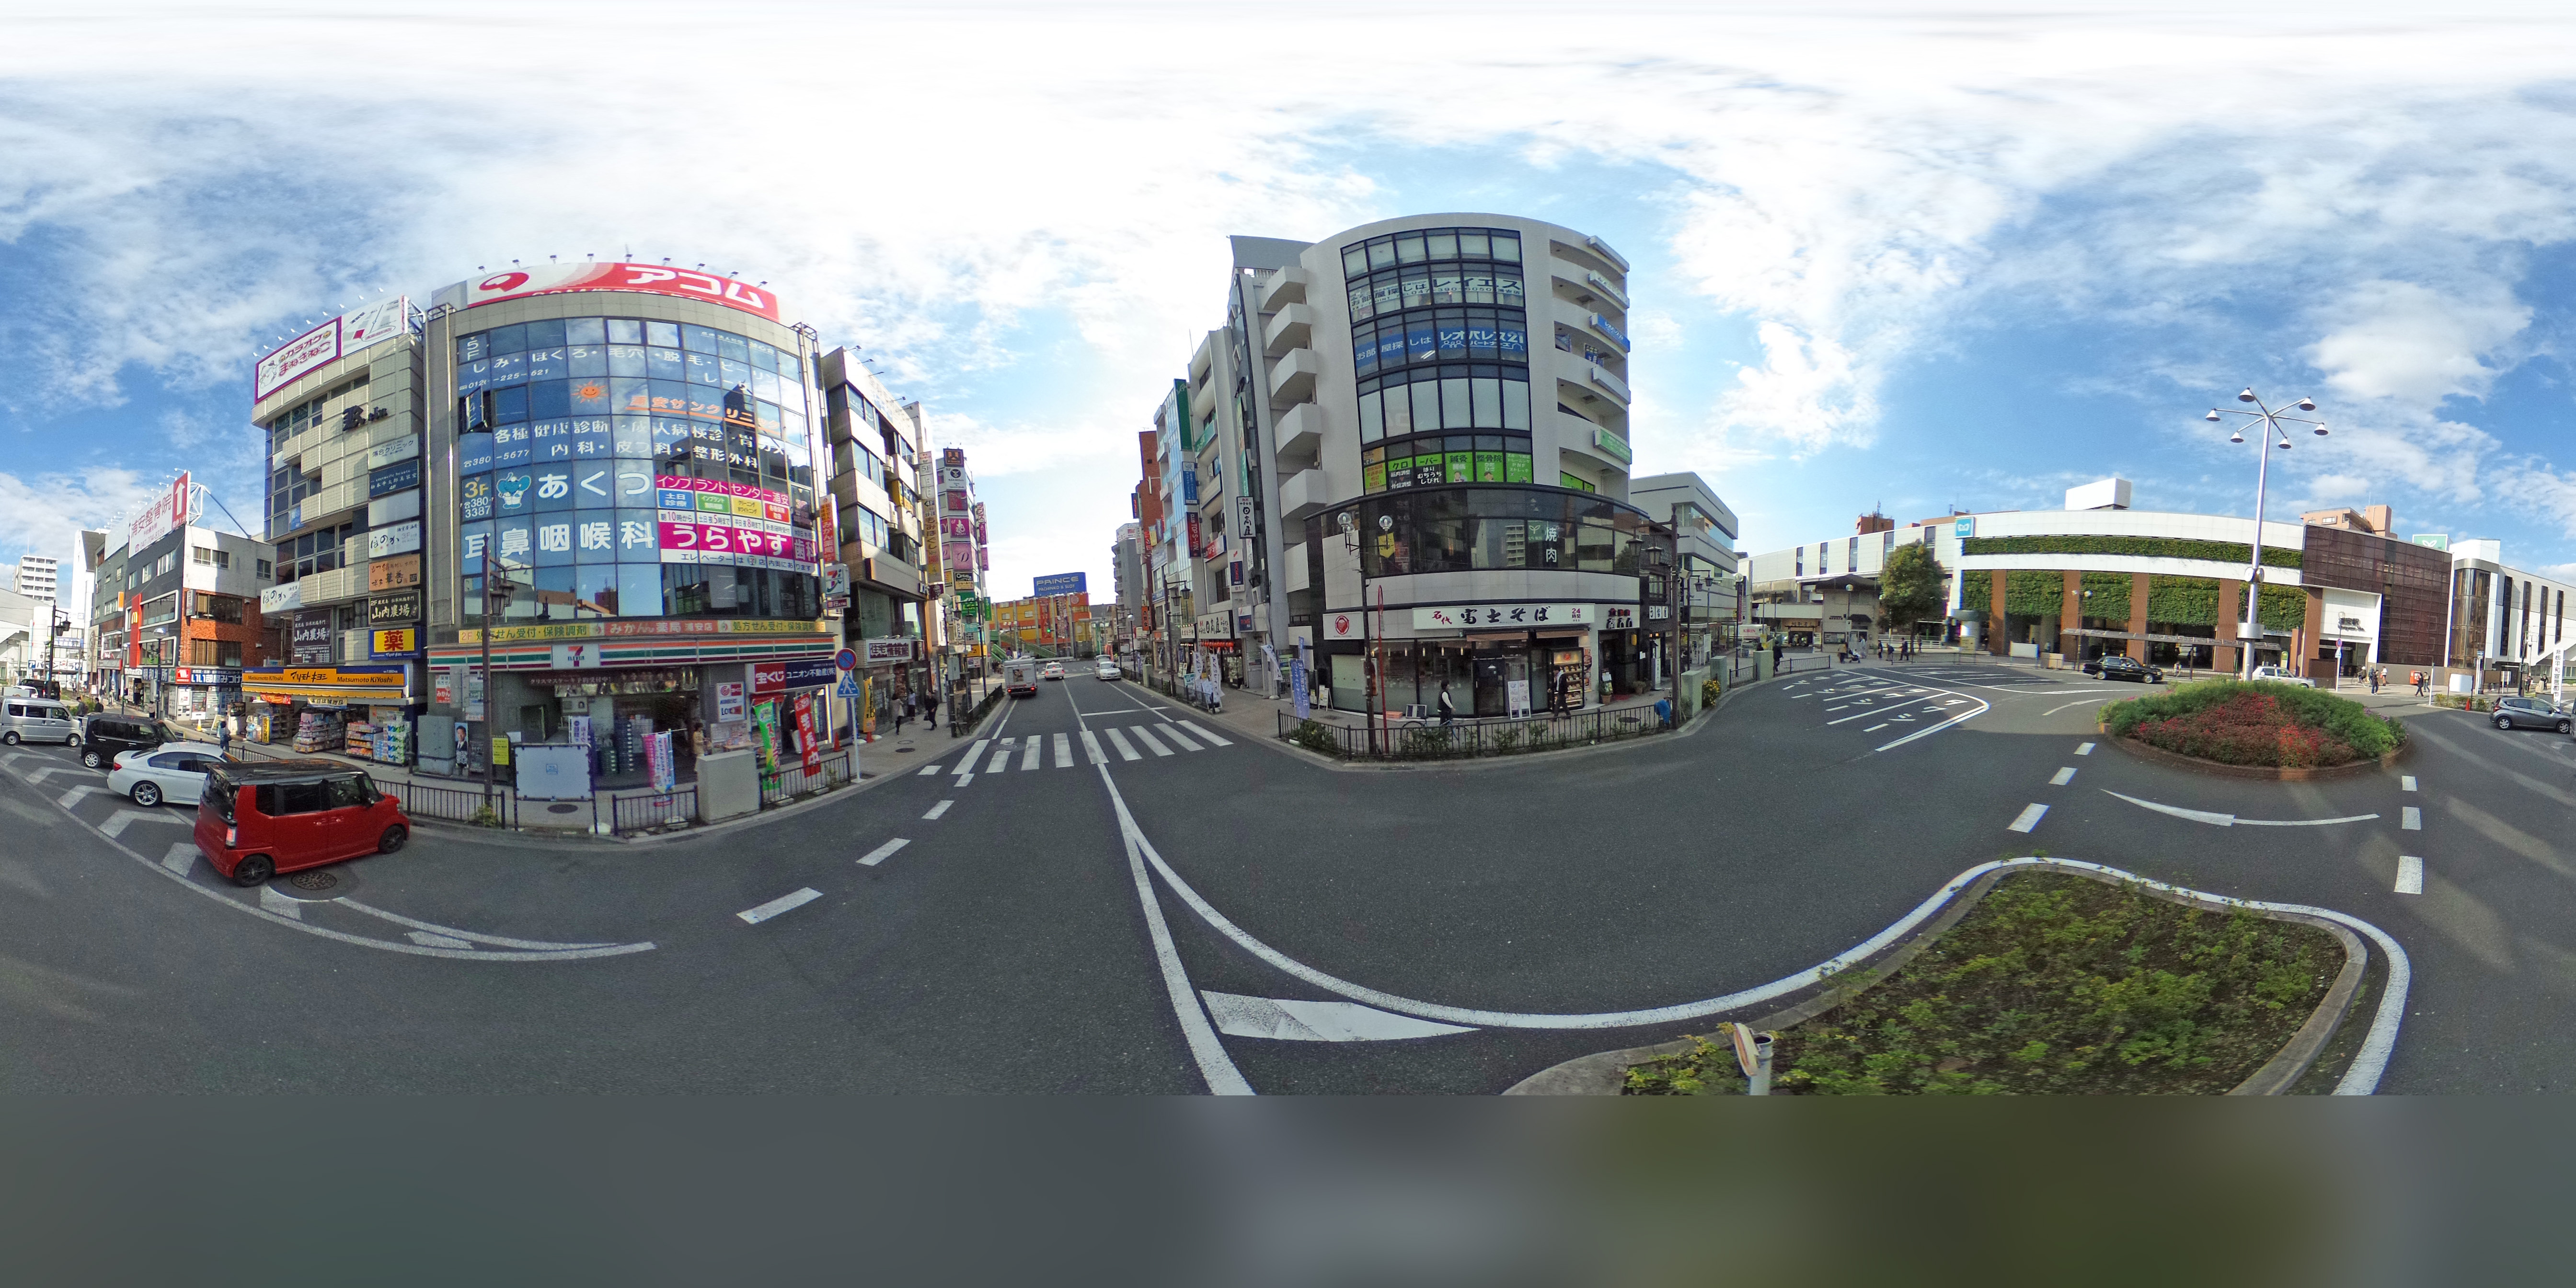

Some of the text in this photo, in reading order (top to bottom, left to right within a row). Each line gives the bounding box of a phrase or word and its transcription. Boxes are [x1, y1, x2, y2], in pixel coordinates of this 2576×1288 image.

[626, 267, 764, 308] アコム
[1433, 278, 1521, 290] レイエス
[1357, 330, 1524, 360] お部屋探しは レオパレス21
[279, 340, 332, 378] まねきねこ
[1392, 456, 1438, 469] クローバー
[1476, 454, 1503, 462] 整骨院
[464, 481, 489, 498] 3F
[539, 471, 651, 498] あくつ
[657, 475, 789, 506] インプラントセンター浦安
[465, 506, 491, 518] 3387
[1242, 506, 1253, 536] 日高屋
[464, 520, 655, 560] 耳鼻咽喉科
[673, 524, 817, 562] うらやす歯科
[1545, 527, 1558, 563] 焼肉
[681, 552, 744, 564] エレベーターは
[1036, 576, 1079, 586] PRINCE
[371, 603, 410, 620] 山内農場
[1460, 606, 1552, 624] 富士そば
[610, 621, 713, 634] みかん薬局 浦安店
[1205, 616, 1222, 634] 日高屋
[294, 627, 326, 643] 山内農場
[384, 630, 404, 651] 薬
[461, 632, 473, 642] 2F
[870, 644, 909, 658] 住宅情報館
[290, 671, 328, 682] マツモトキヨシ
[755, 667, 836, 684] 宝くじ ユニオン不動産(株)
[2553, 649, 2562, 697] 非核平和宣言都市
